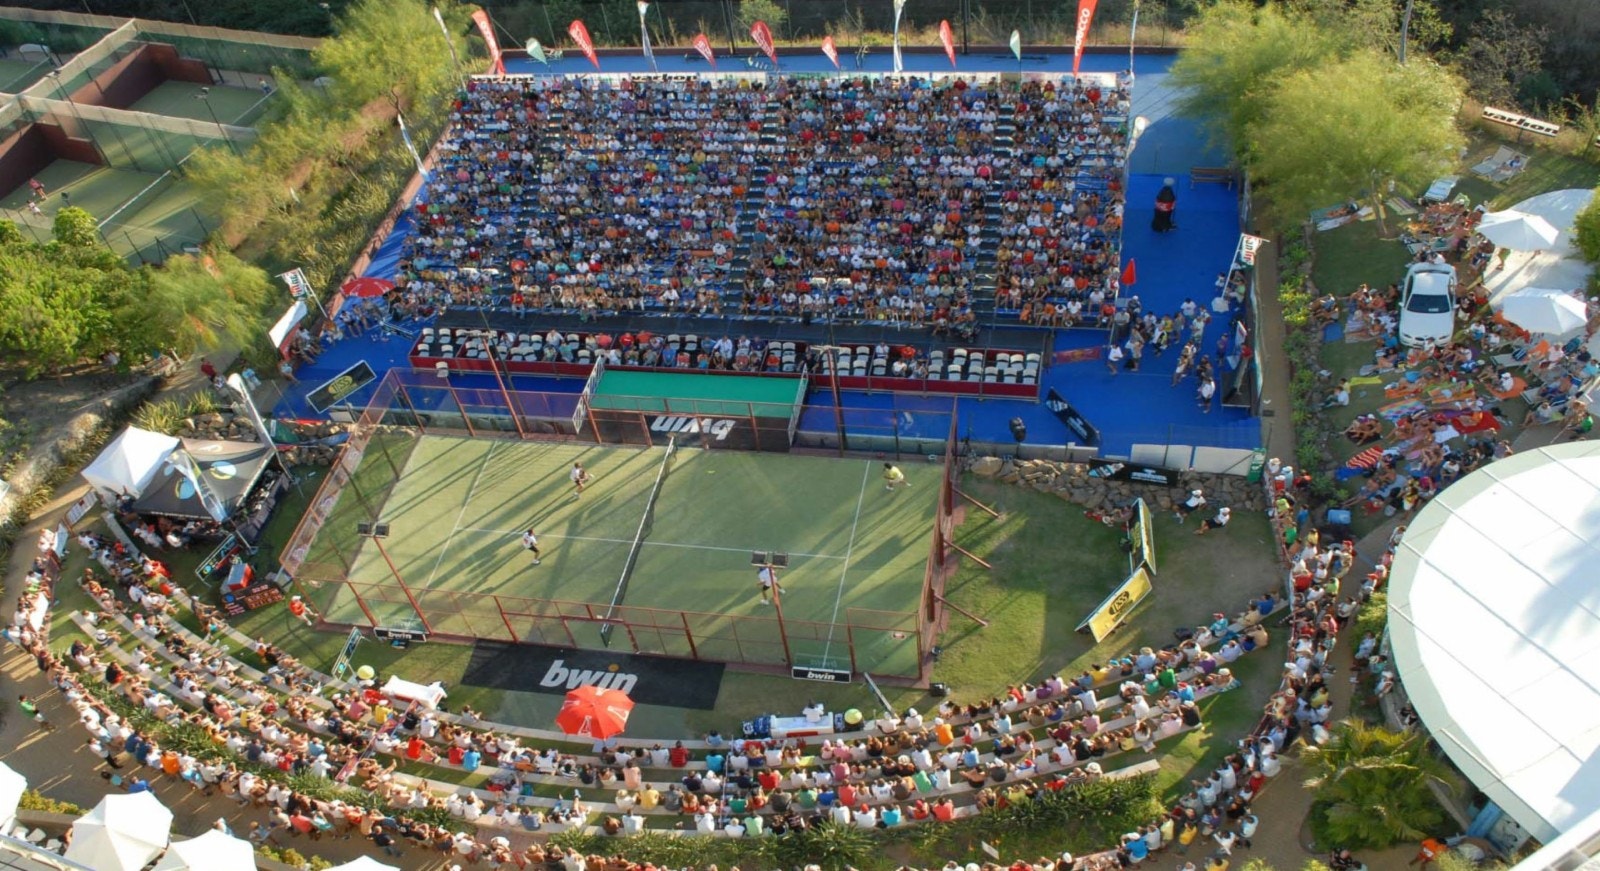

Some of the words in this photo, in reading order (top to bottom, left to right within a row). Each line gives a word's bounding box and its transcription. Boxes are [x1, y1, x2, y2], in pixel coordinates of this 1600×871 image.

[1483, 110, 1559, 135] varlion
[650, 415, 736, 441] bwin
[388, 630, 413, 640] bwin
[539, 659, 639, 695] bwin
[807, 671, 836, 681] bwin
